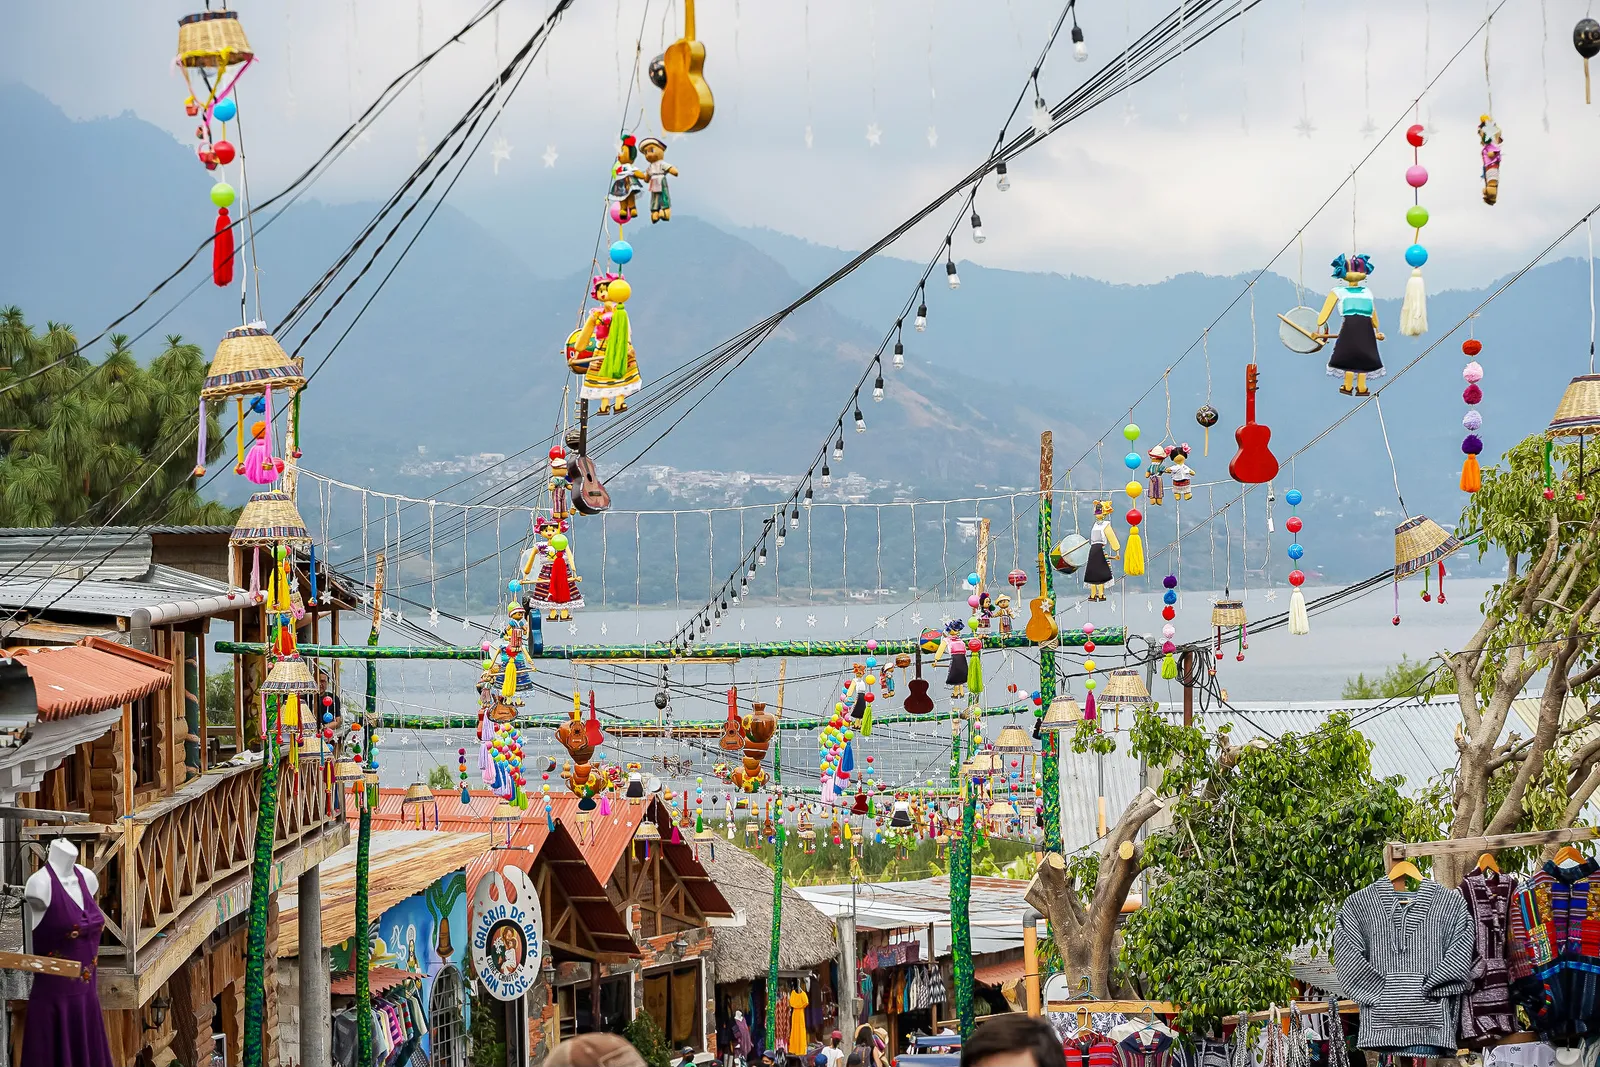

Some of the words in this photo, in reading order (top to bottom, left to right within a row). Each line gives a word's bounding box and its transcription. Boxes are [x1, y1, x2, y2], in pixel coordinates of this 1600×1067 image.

[474, 904, 507, 950] GALERIA
[510, 906, 526, 924] DE
[523, 923, 539, 959] ARTE
[480, 967, 499, 993] SAN
